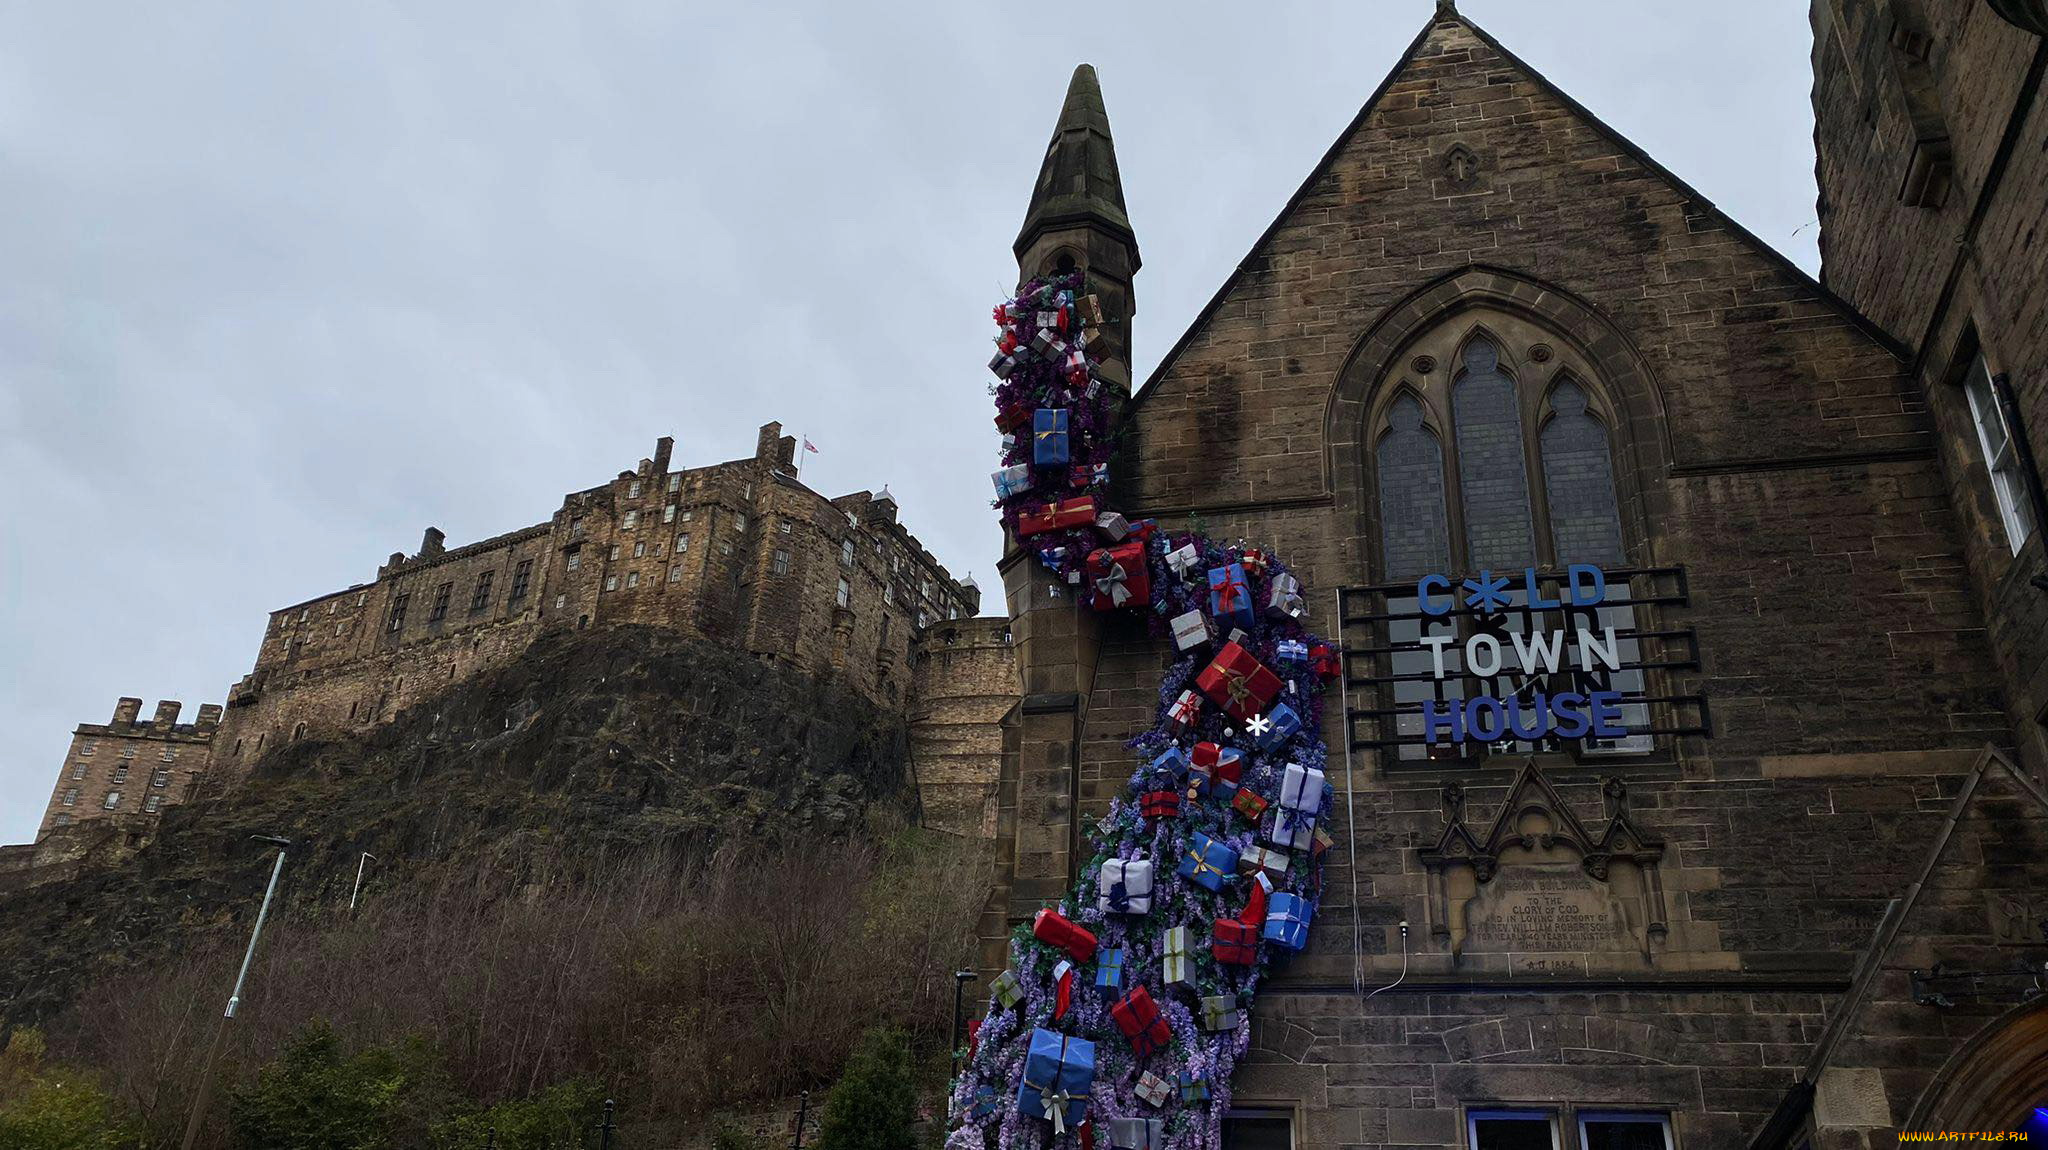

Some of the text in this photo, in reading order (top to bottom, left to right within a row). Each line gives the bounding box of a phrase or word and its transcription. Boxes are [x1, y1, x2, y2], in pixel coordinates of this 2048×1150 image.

[1420, 626, 1620, 679] TOWN
[1423, 691, 1628, 743] HOUSE
[1545, 897, 1562, 905] THE
[1557, 914, 1596, 922] MEMORY
[1598, 914, 1609, 922] OF
[1513, 924, 1552, 932] WILLIAM
